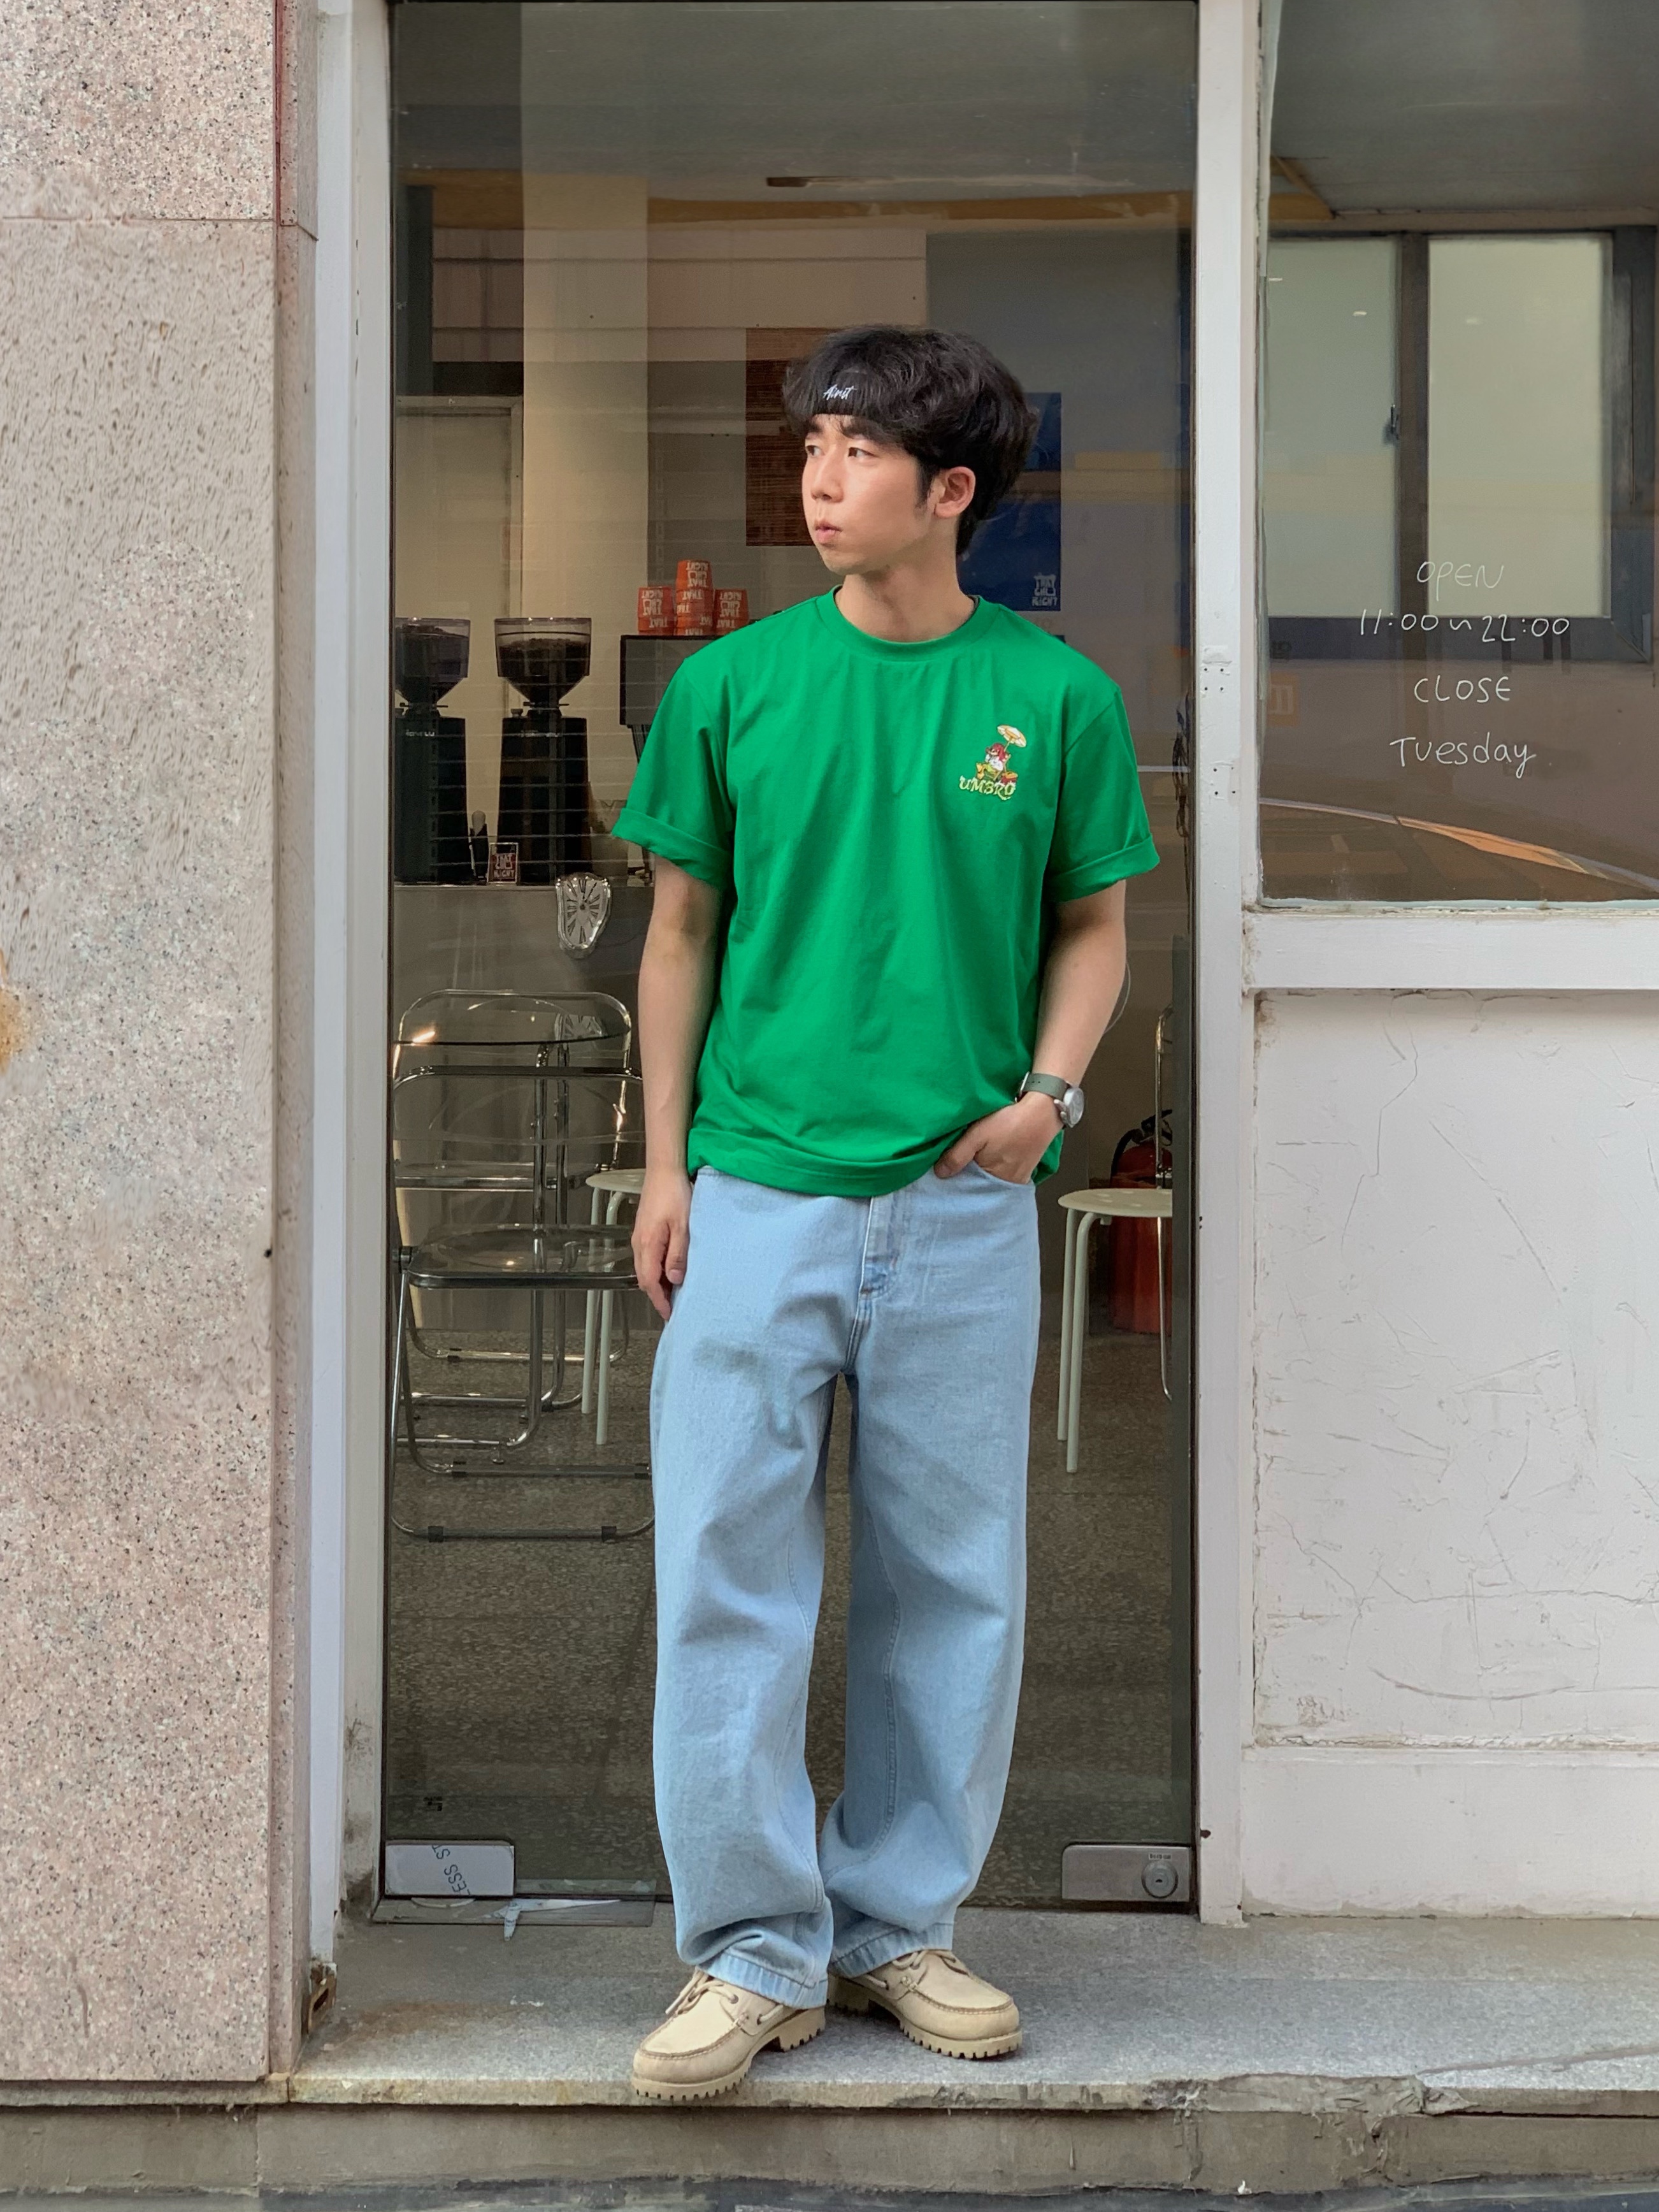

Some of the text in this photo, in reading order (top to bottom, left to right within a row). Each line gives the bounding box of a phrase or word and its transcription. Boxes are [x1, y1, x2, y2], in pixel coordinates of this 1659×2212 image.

[1416, 560, 1505, 602] OPEN
[1413, 674, 1512, 703] CLOSE
[1389, 732, 1537, 779] Tuesday
